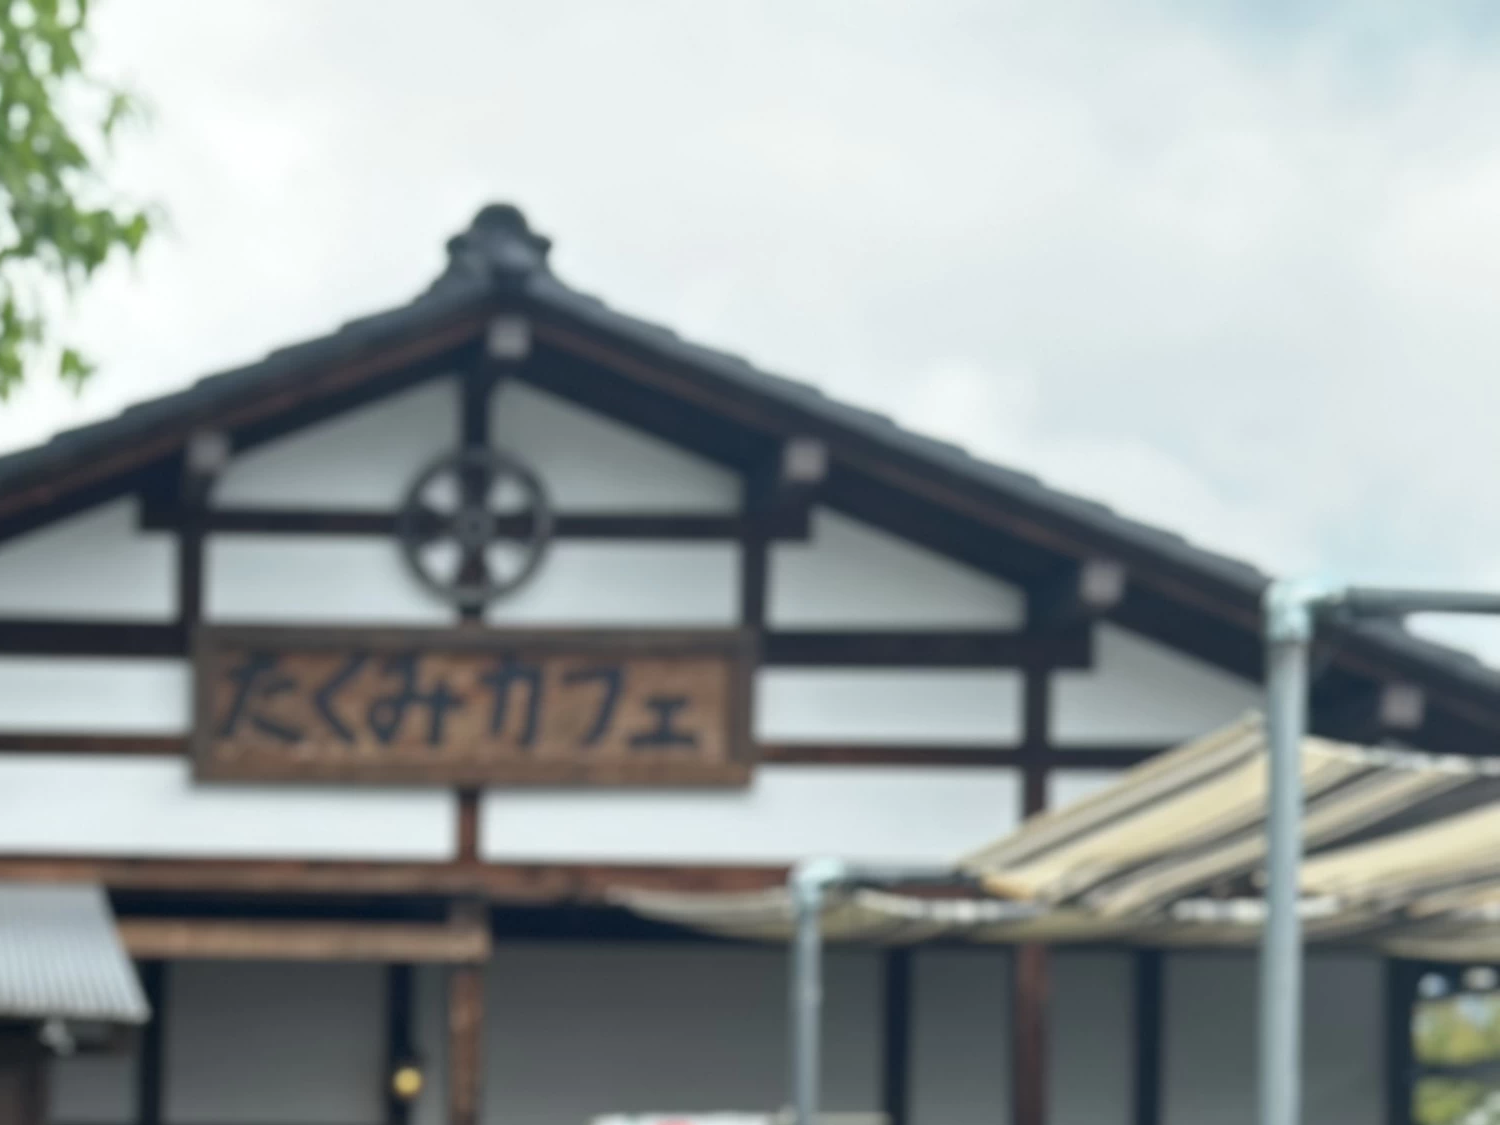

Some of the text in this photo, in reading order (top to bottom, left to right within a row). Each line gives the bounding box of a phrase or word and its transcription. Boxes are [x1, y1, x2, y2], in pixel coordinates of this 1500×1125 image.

[214, 648, 698, 750] たくみカフェ
